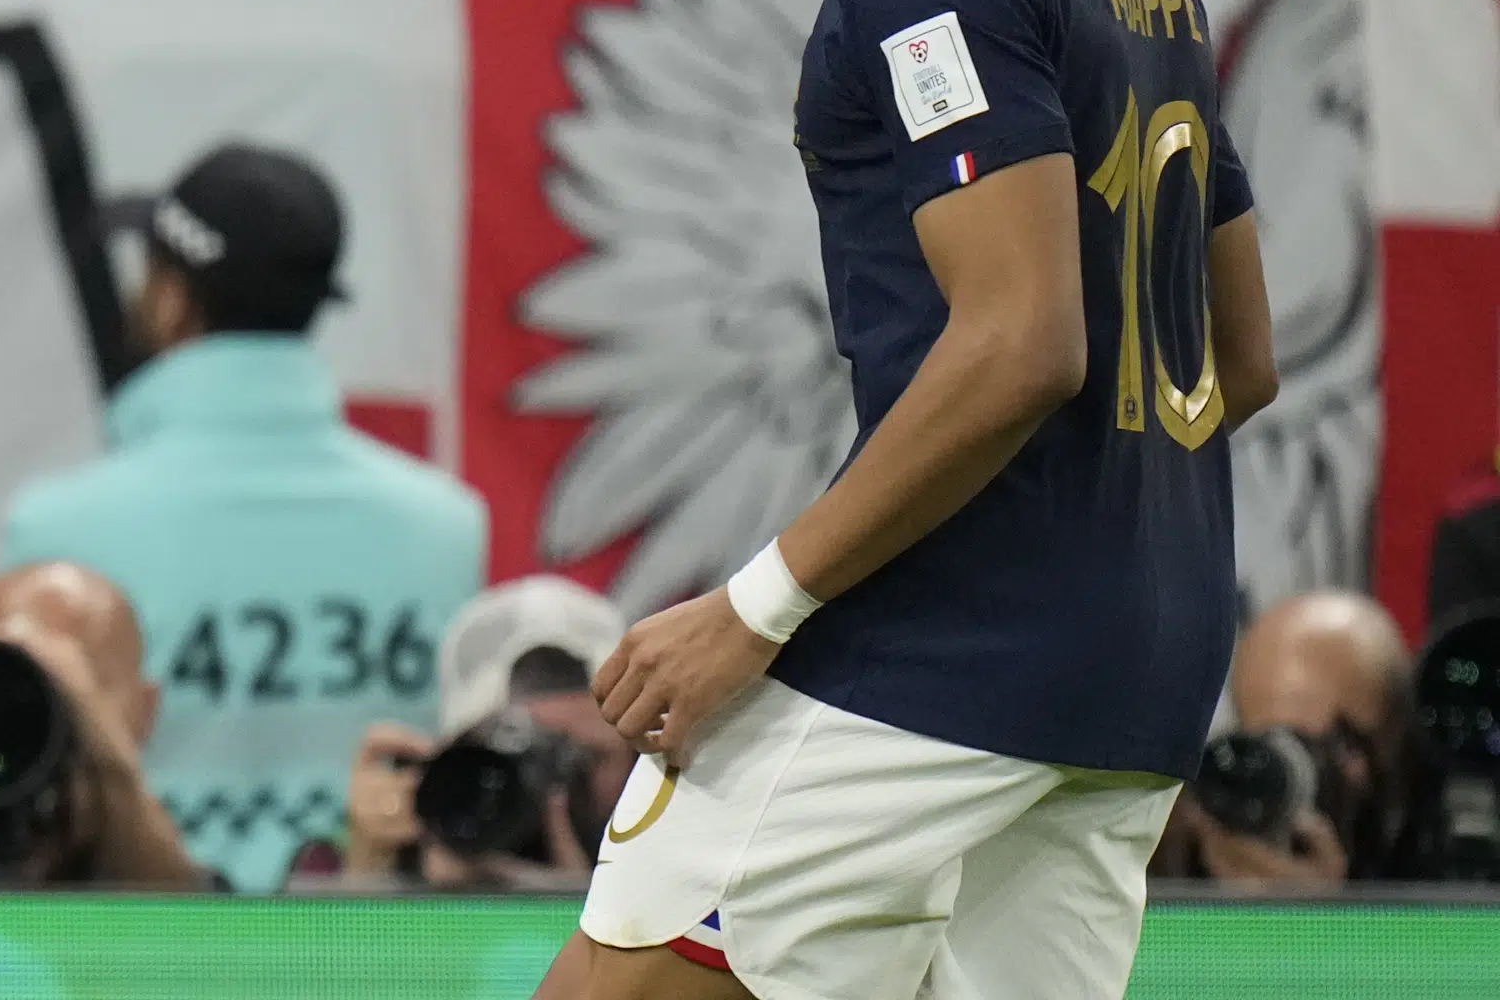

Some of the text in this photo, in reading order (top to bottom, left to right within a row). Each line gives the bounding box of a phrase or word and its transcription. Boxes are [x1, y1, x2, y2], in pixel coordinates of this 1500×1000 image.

[916, 71, 947, 94] UNITES
[1087, 83, 1225, 452] 10
[167, 594, 436, 704] 4236
